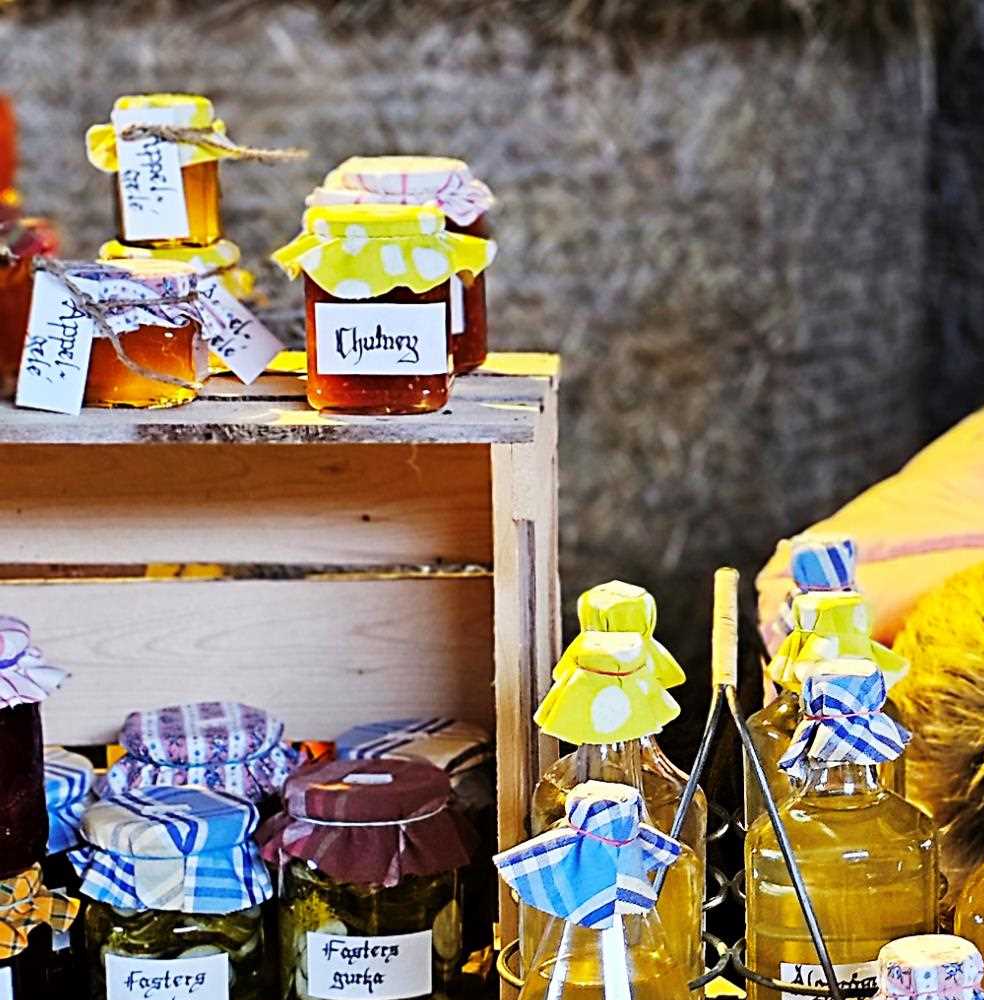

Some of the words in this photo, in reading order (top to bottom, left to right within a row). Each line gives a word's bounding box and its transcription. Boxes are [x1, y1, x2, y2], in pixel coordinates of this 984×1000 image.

[335, 323, 420, 366] Chutney
[322, 939, 400, 965] Fasters
[124, 969, 207, 999] Fasters
[329, 967, 386, 994] gurka
